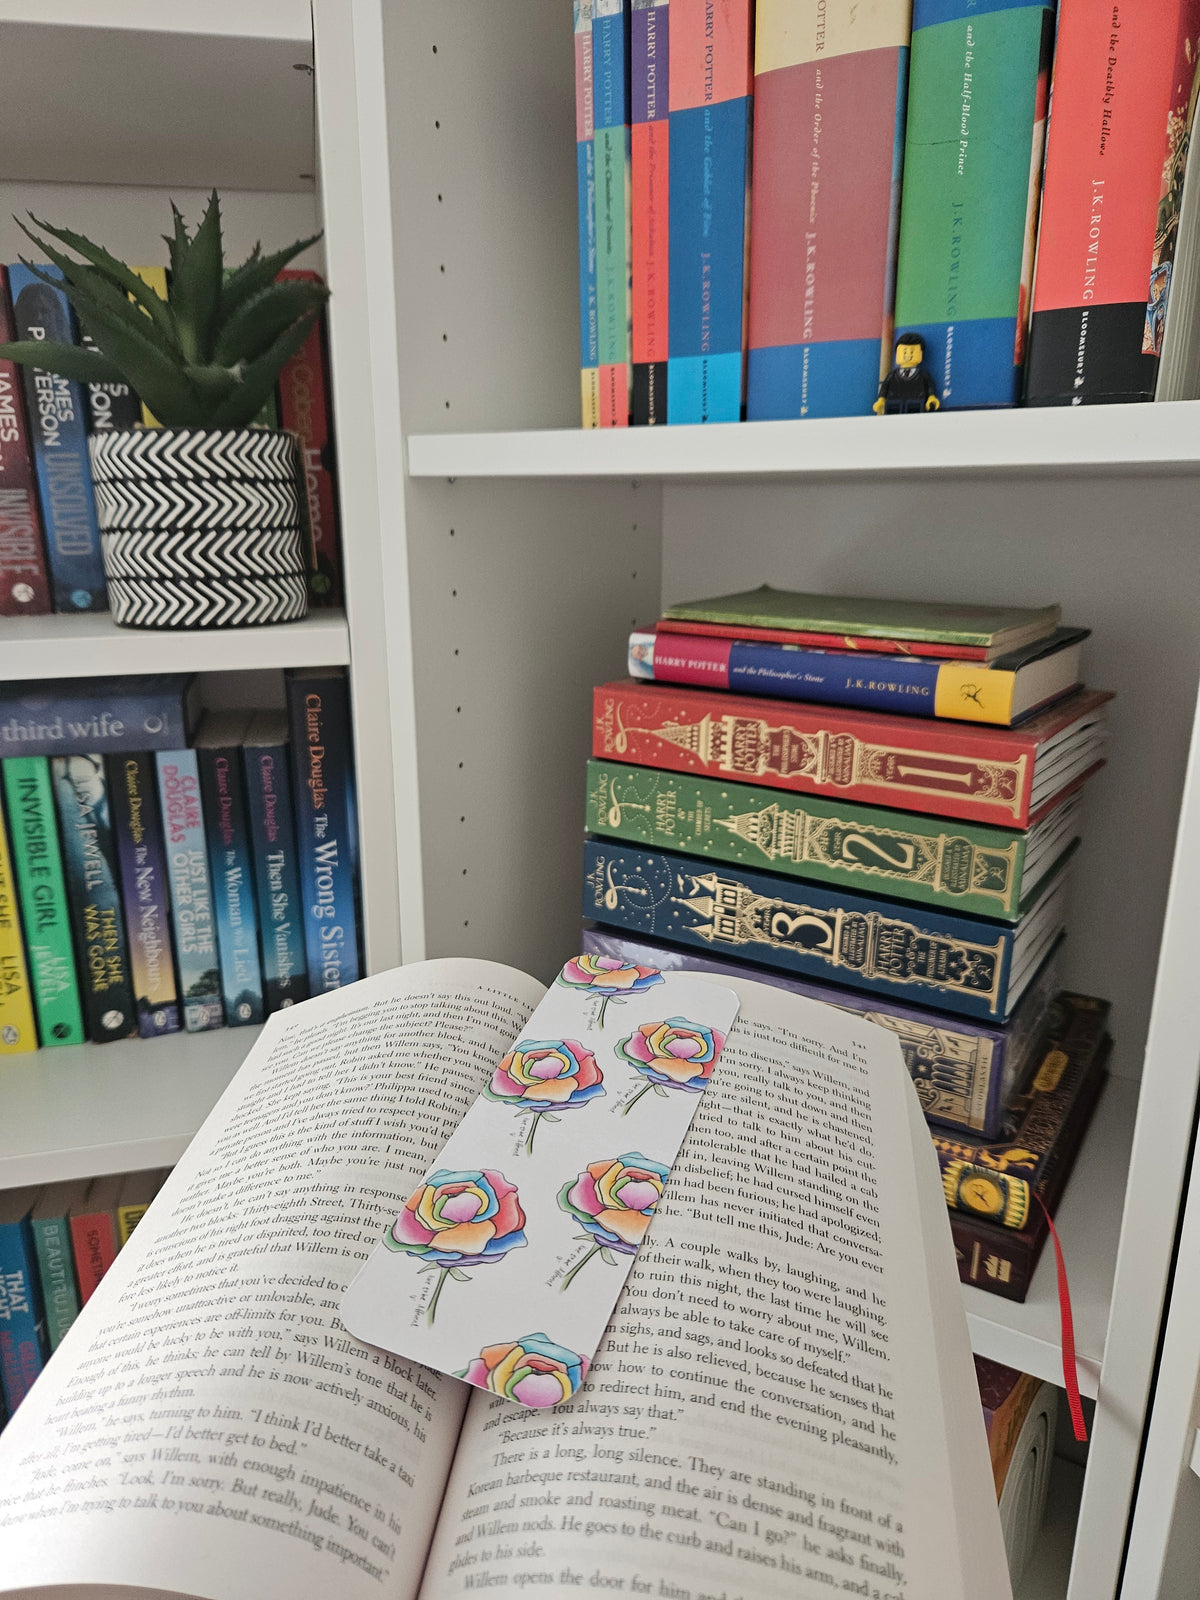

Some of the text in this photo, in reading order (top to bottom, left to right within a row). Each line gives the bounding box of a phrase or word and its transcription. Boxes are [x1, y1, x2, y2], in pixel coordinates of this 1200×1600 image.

[603, 20, 613, 66] HARRY
[647, 11, 656, 58] HARRY
[704, 0, 714, 101] ARRY POTTER
[815, 0, 827, 52] OTTER
[584, 33, 593, 83] HARRY
[815, 69, 825, 90] and
[1098, 5, 1121, 156] and the Deathly Hallows
[584, 86, 594, 137] POTTER
[604, 70, 614, 126] POTTER
[647, 64, 656, 120] POTTER
[814, 93, 824, 110] the
[957, 24, 976, 176] and the Half-Blood Prince
[811, 148, 821, 161] of
[813, 113, 823, 145] Order
[811, 162, 821, 178] the
[1082, 179, 1105, 302] J.K.ROWLING
[1075, 310, 1089, 374] BLOOMSBURY
[28, 326, 61, 448] PERSON
[53, 370, 75, 424] MES
[45, 452, 94, 556] UNSOLVED
[655, 655, 727, 673] HARRY POTTER
[733, 666, 825, 685] and the Philosopher's Stone
[845, 678, 930, 697] J.K.ROWLING
[1, 711, 125, 742] third wife
[304, 692, 329, 811] Claire Douglas
[604, 698, 615, 754] ROWLING
[734, 723, 746, 769] HARRY
[744, 722, 759, 773] POTTER
[125, 759, 145, 844] Claire Douglas
[179, 775, 201, 830] CLAIRE
[215, 757, 235, 845] Claire Douglas
[259, 755, 280, 843] Claire Douglas
[598, 772, 609, 827] ROWLING
[896, 764, 972, 788] 1
[162, 765, 187, 844] DOUGLAS
[655, 790, 678, 836] HARRY POTTER
[16, 777, 59, 935] INVISIBLE GIRL
[75, 822, 105, 891] JEWELL
[832, 831, 842, 856] YEAR
[842, 833, 914, 870] 2
[958, 845, 970, 889] MINALIMA
[172, 852, 198, 954] OTHER GIRLS
[187, 850, 214, 953] JUST LIKE THE
[224, 866, 243, 927] Woman
[312, 813, 345, 990] The Wrong Sister
[594, 855, 606, 907] ROWLING
[135, 844, 164, 993] The New Neighbours
[264, 849, 295, 989] Then She Vanishes
[771, 911, 833, 950] 3
[855, 921, 867, 963] MINALIMA
[84, 902, 110, 993] WAS GONE
[100, 906, 124, 985] THEN SHE
[878, 929, 893, 971] HARRY
[889, 927, 906, 977] POTTER
[917, 950, 927, 963] THE
[926, 949, 937, 979] PRISONER
[937, 949, 948, 976] AZKABAN
[0, 953, 23, 997] LISA
[31, 945, 57, 1006] JEWELL
[487, 987, 519, 1003] LITTLE
[699, 1112, 876, 1171] tried to talk to him about his cut-
[6, 1269, 30, 1314] THAT
[620, 1303, 851, 1364] always be able to take care of myself."
[652, 1286, 891, 1361] don't need to worry about me, Willem.
[293, 1333, 319, 1347] says
[324, 1335, 369, 1361] Willem
[372, 1355, 380, 1365] a
[383, 1355, 413, 1383] block
[493, 1443, 682, 1470] There is a long, long silence.
